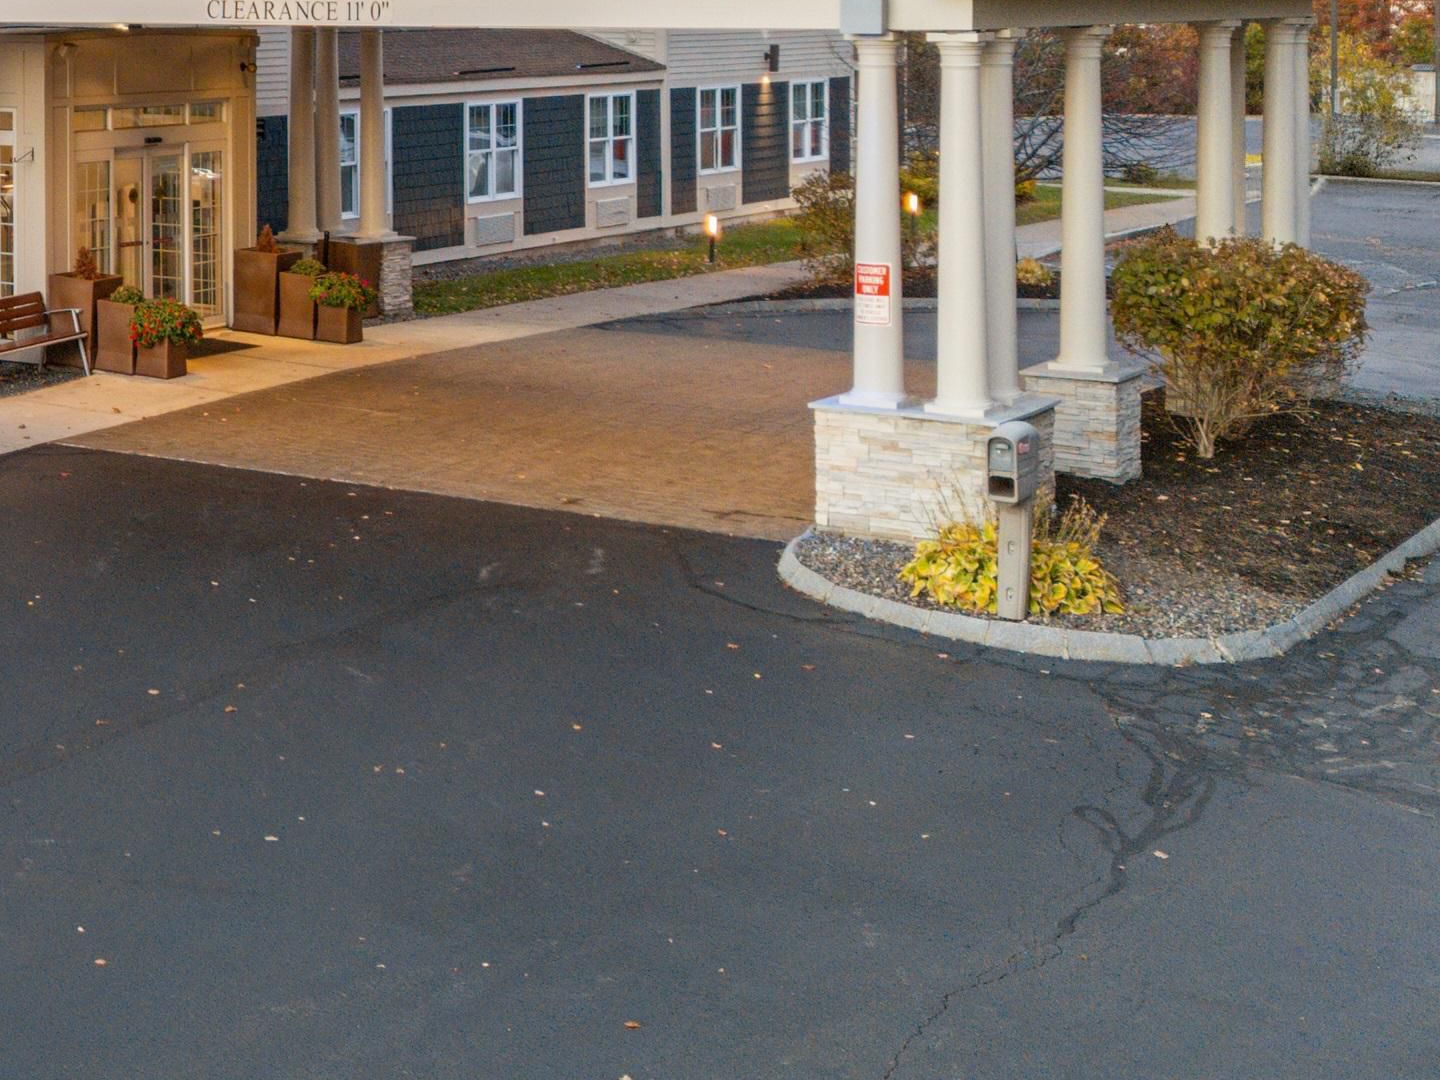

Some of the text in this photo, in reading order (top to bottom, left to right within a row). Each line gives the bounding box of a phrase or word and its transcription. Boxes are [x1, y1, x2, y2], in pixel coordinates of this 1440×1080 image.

[207, 0, 390, 21] CLEARANCE 11' 0"
